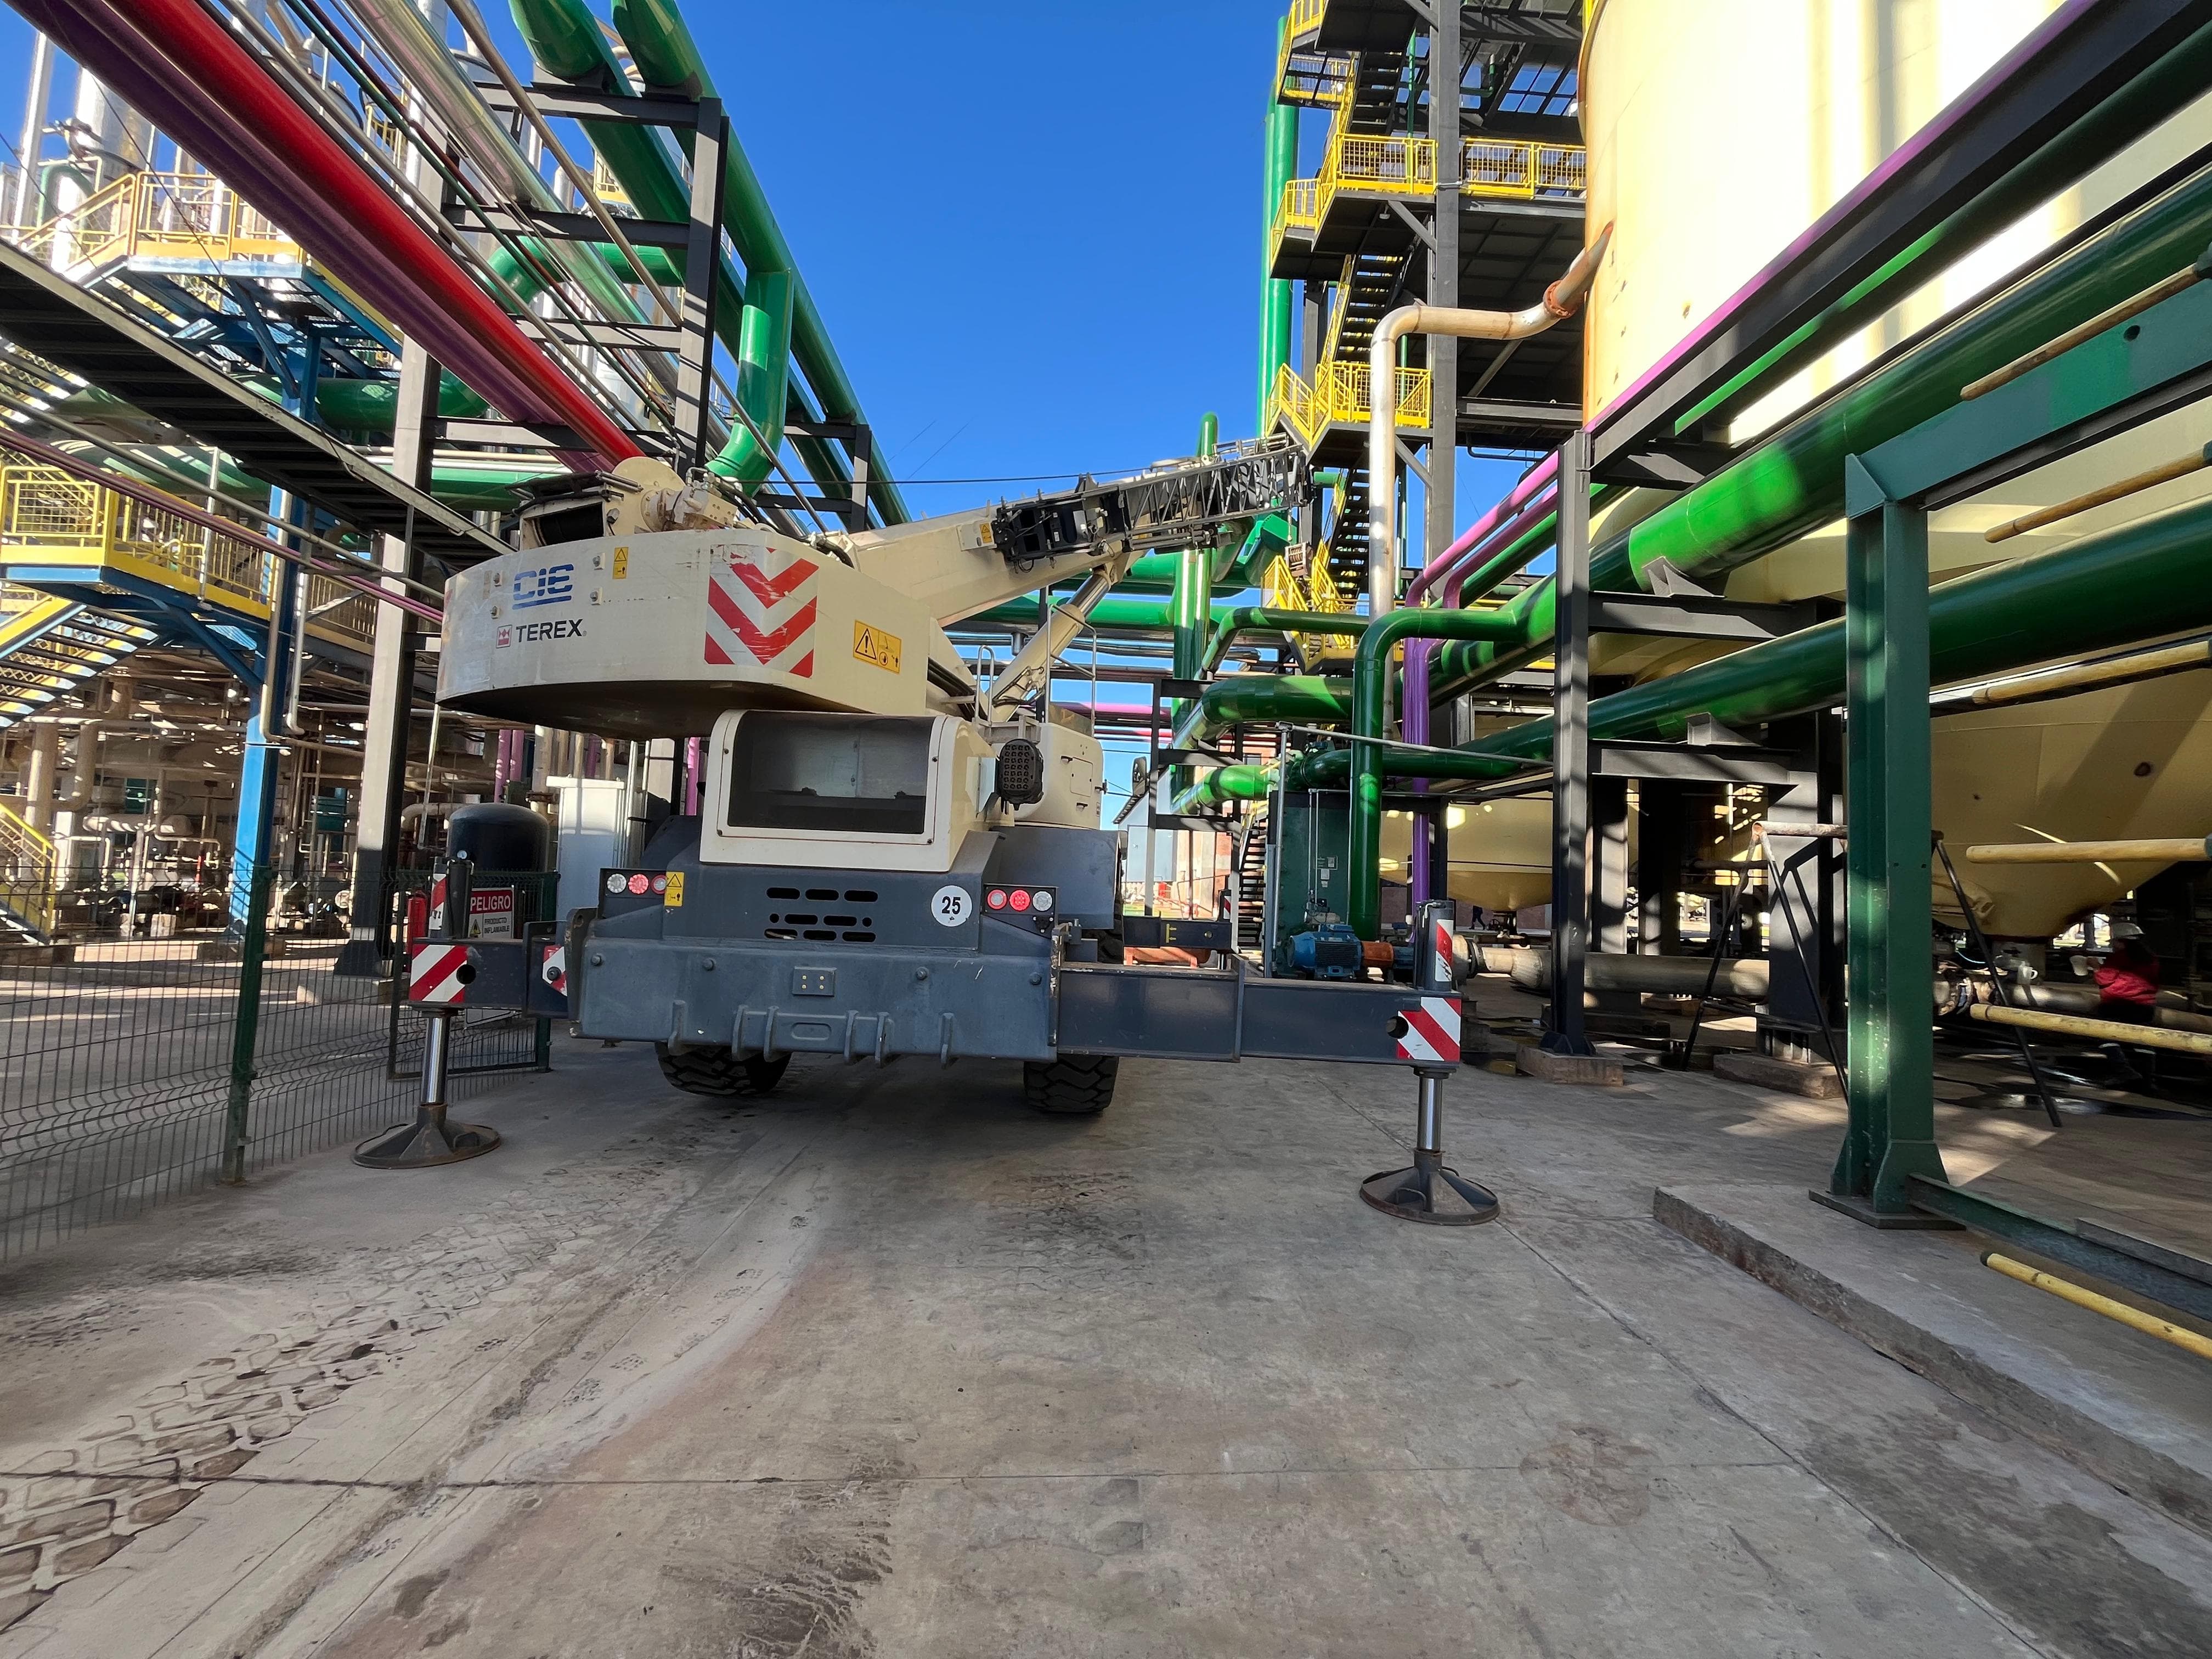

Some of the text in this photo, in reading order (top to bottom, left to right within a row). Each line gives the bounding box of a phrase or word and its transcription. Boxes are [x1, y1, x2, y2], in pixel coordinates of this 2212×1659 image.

[513, 563, 574, 601] CIE
[516, 618, 583, 643] TEREX
[470, 895, 510, 911] PELIGRO
[942, 896, 961, 915] 25
